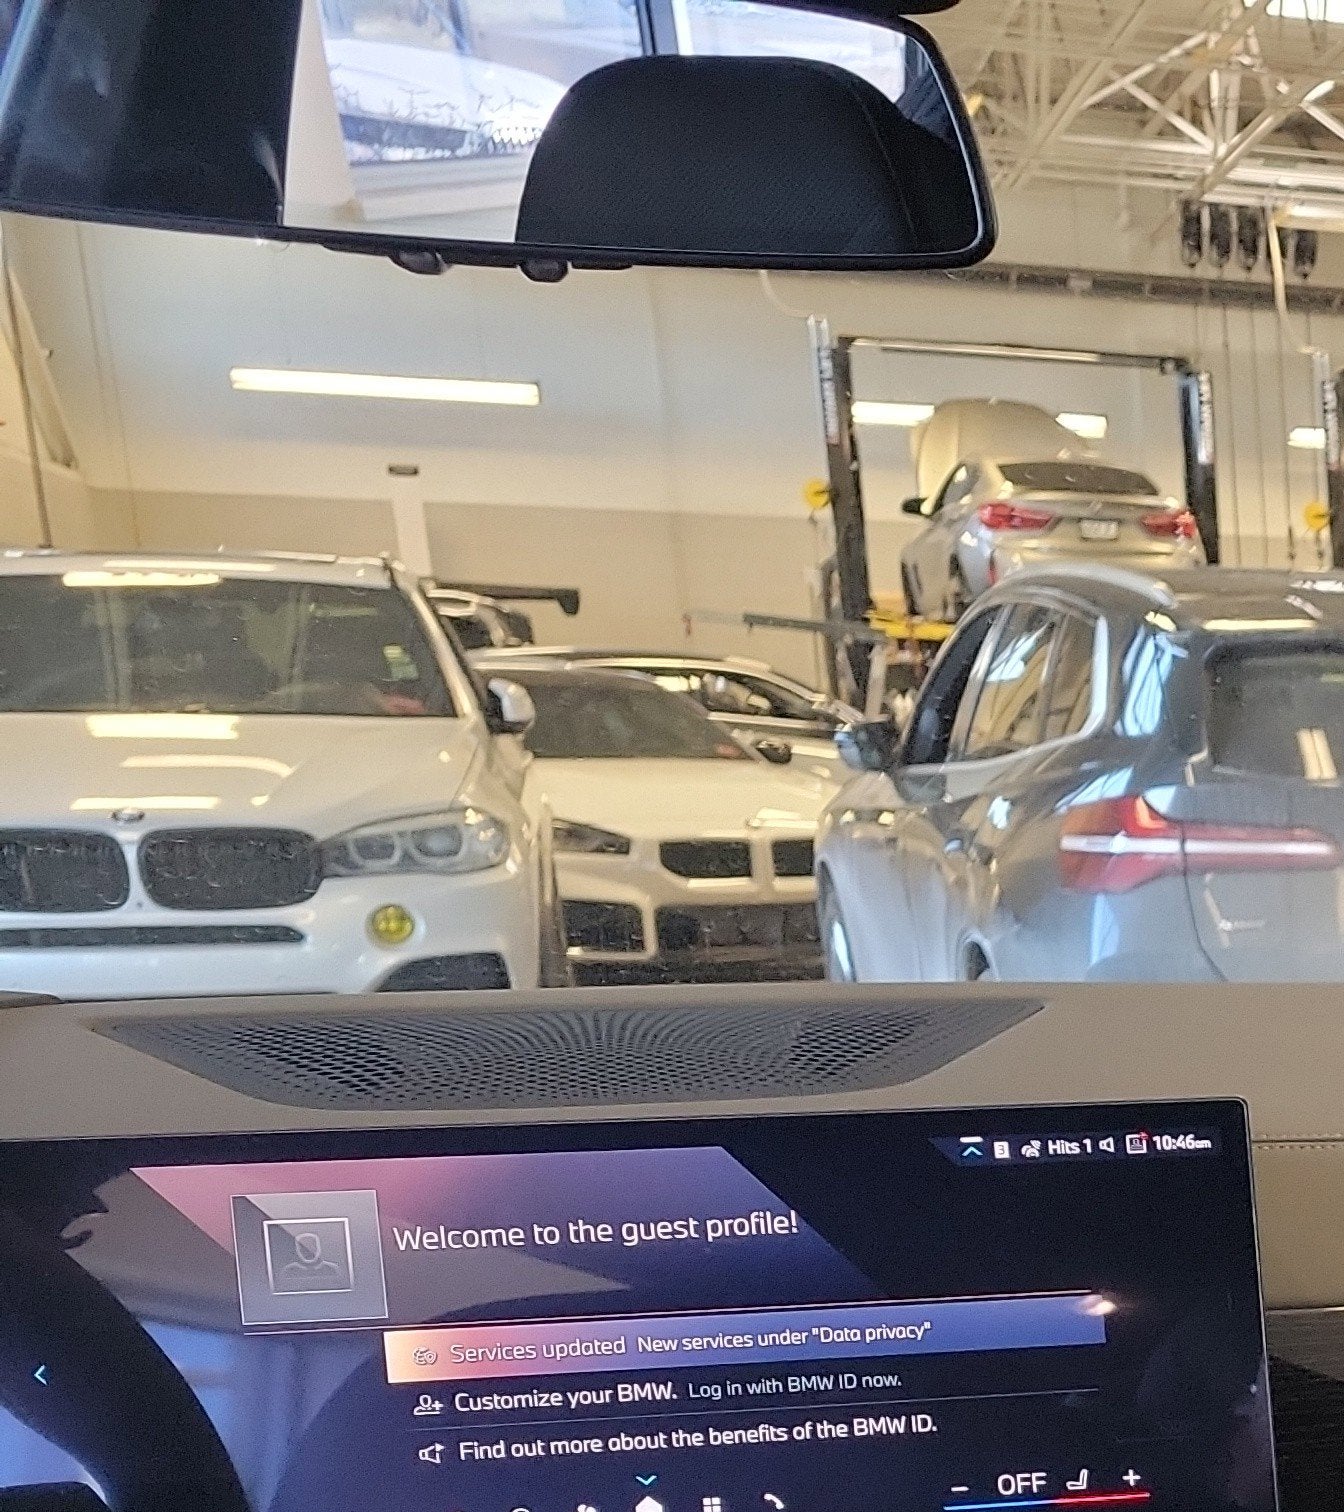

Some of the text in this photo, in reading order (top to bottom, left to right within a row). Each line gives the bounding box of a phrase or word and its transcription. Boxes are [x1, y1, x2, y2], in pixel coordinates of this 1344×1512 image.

[1047, 1138, 1093, 1156] Hits 1
[393, 1209, 798, 1251] Welcome to the guest profile!
[450, 1321, 931, 1364] Services updated New services under "Data privacy"
[454, 1373, 902, 1412] Customize your BMW. Log in with BMW ID now.
[459, 1413, 938, 1461] Find out more about the benefits of the BMW ID.
[997, 1472, 1047, 1495] OFF
